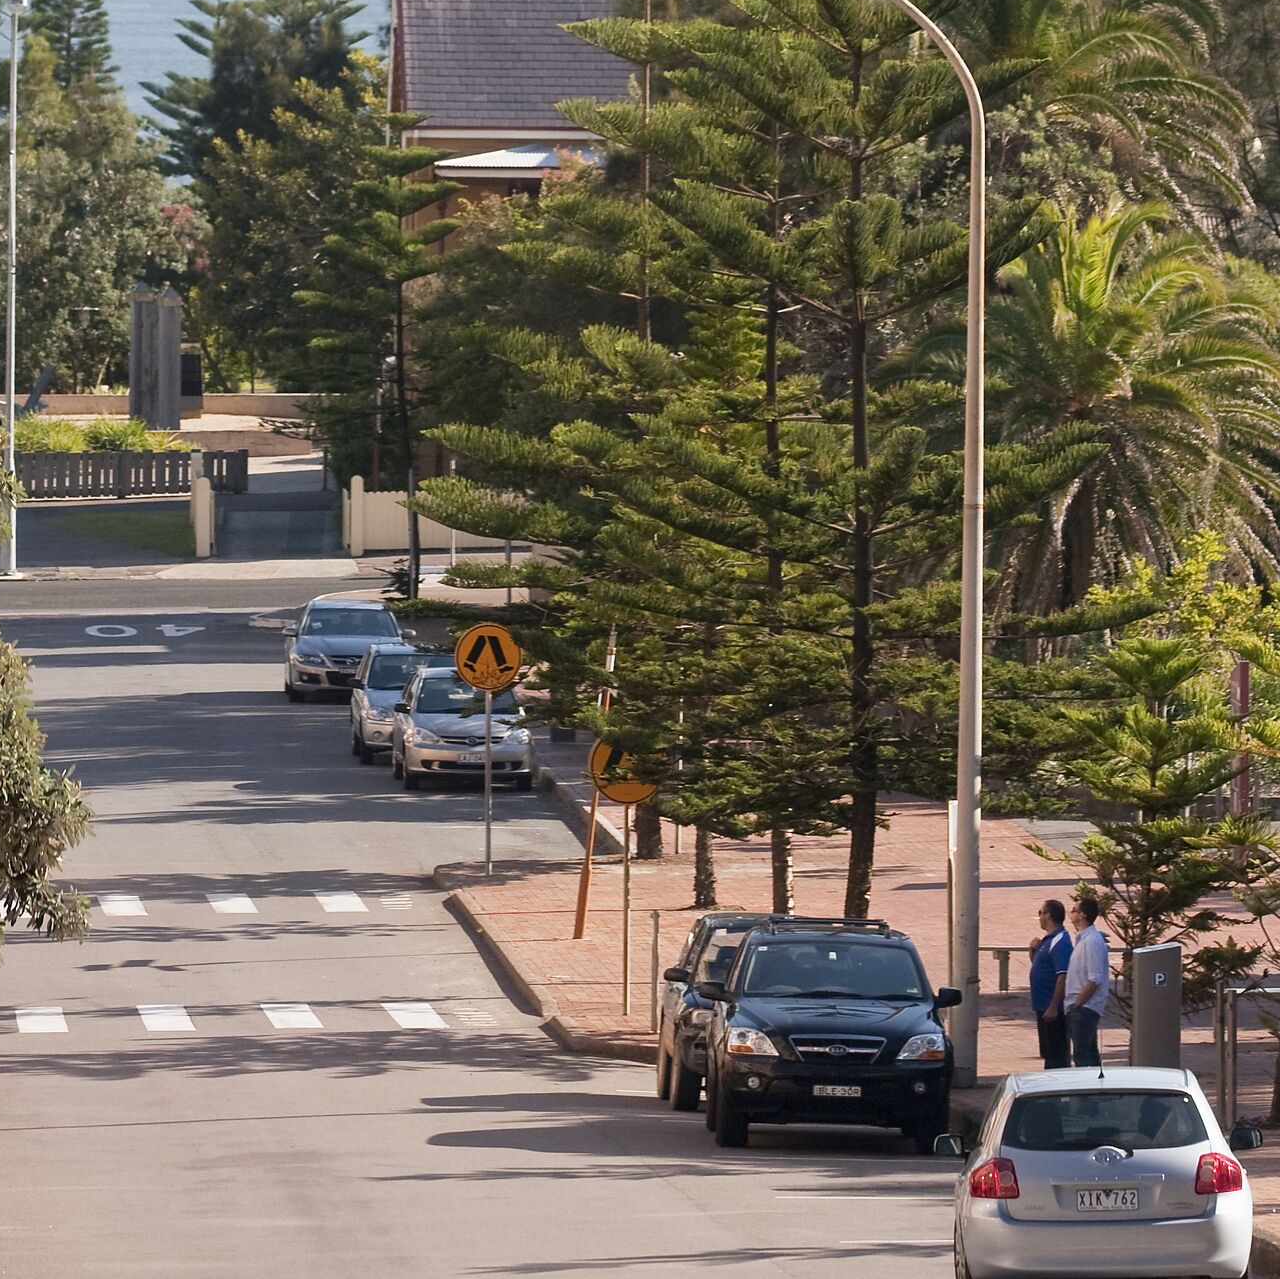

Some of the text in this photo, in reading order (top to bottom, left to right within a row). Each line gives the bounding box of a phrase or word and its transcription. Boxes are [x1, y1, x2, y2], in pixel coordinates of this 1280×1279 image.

[84, 624, 207, 637] 40
[1155, 973, 1165, 985] P
[1079, 1192, 1136, 1206] XIK 762
